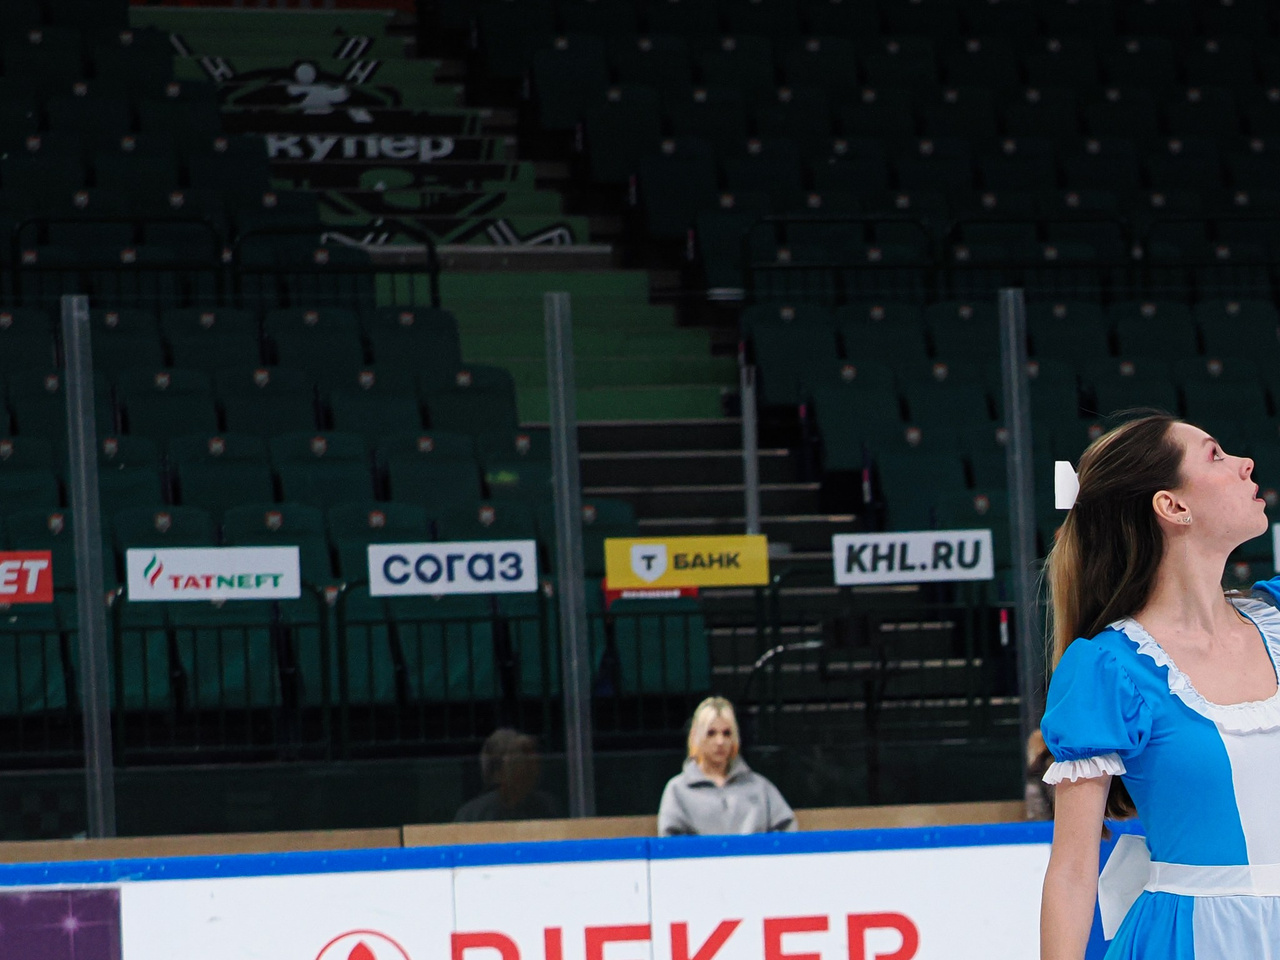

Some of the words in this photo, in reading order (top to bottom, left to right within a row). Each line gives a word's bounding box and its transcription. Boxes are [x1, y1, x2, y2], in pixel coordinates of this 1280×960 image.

[673, 552, 741, 570] БАНК
[845, 540, 981, 573] KHL.RU
[168, 573, 284, 590] TATNEFT
